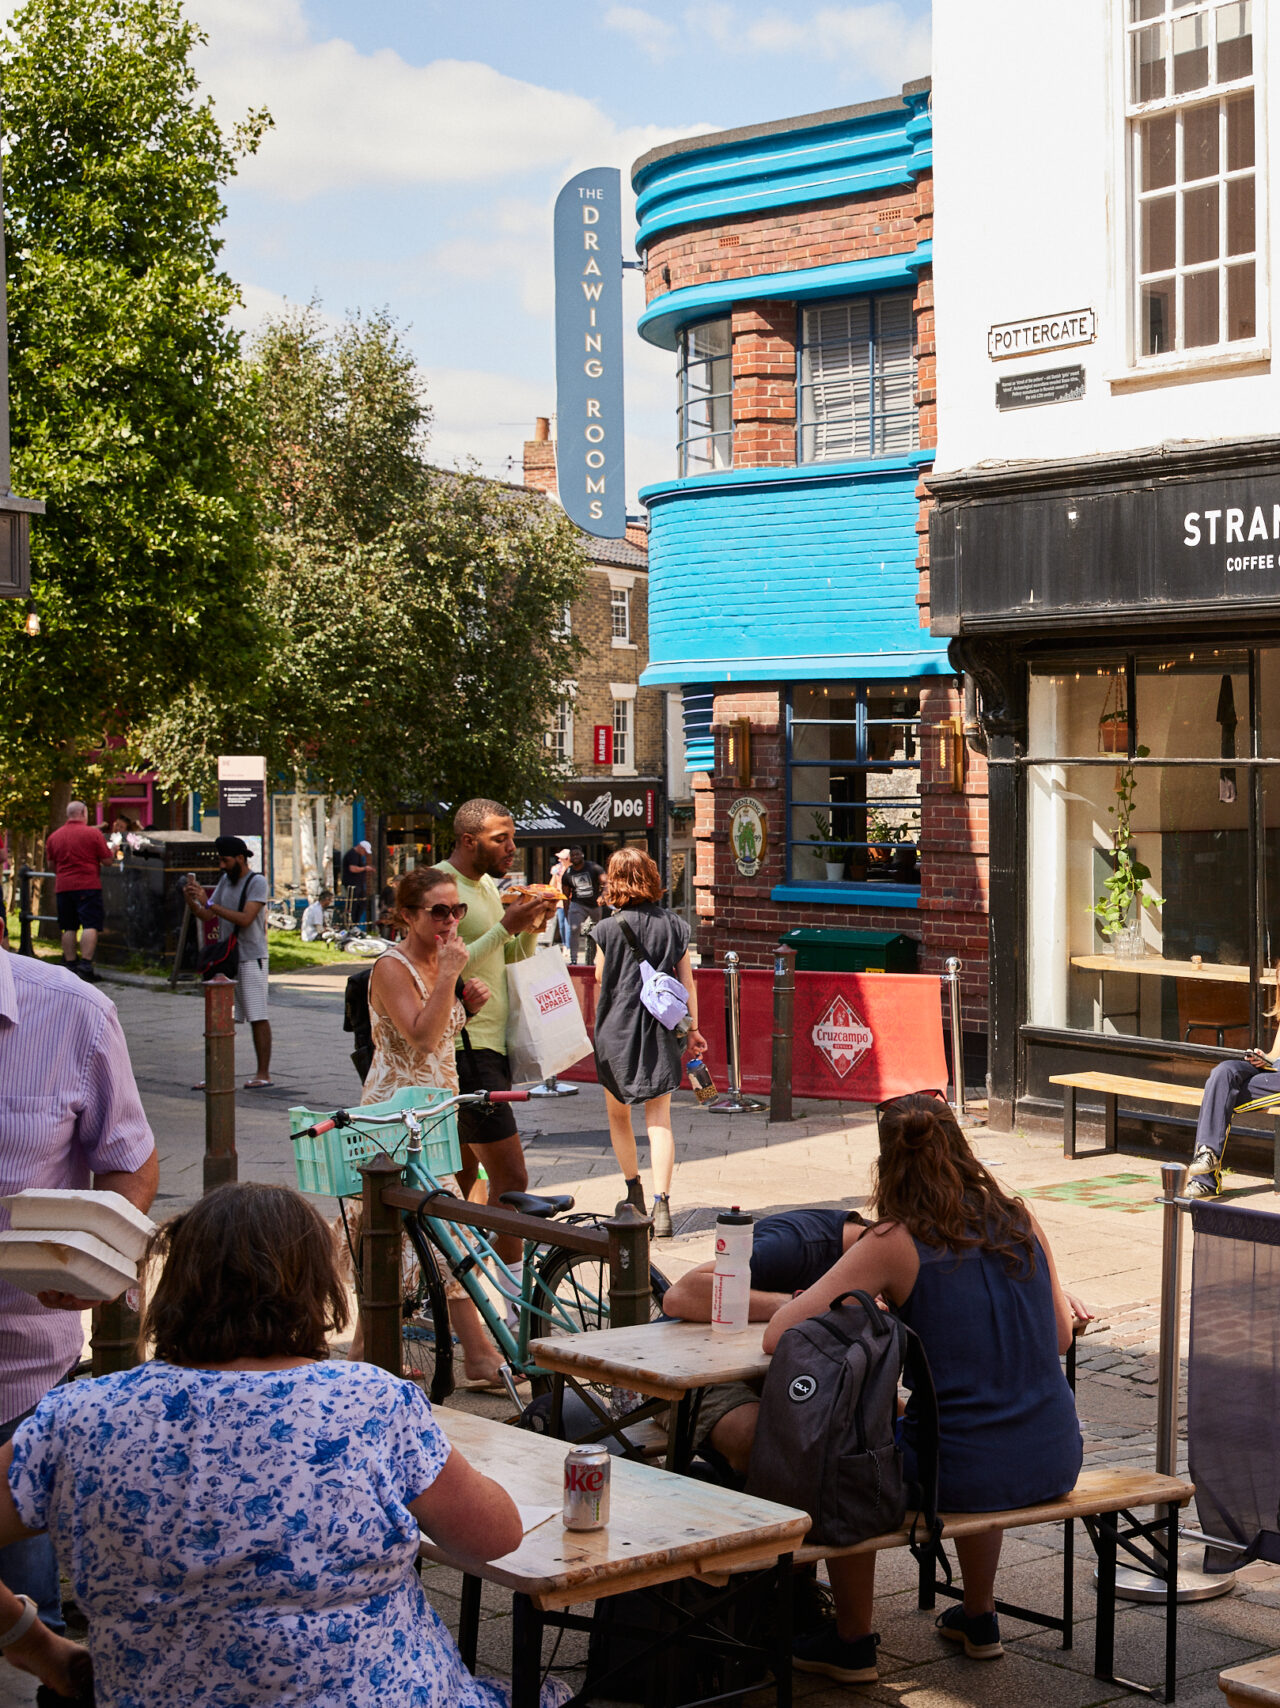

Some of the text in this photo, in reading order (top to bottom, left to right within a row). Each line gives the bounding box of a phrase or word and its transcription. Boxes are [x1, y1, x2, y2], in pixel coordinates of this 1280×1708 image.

[578, 188, 604, 200] THE
[995, 317, 1087, 350] POTTERGATE
[581, 204, 606, 520] DRAWING ROOMS
[1226, 554, 1274, 572] COFFEE
[598, 729, 606, 761] BARBER
[613, 799, 643, 817] DOG
[731, 798, 761, 815] GREENE KING
[536, 984, 569, 1004] VINTAGE
[541, 994, 572, 1012] APPAREL
[816, 1028, 868, 1045] Cruzcampo
[794, 1382, 809, 1393] DLX
